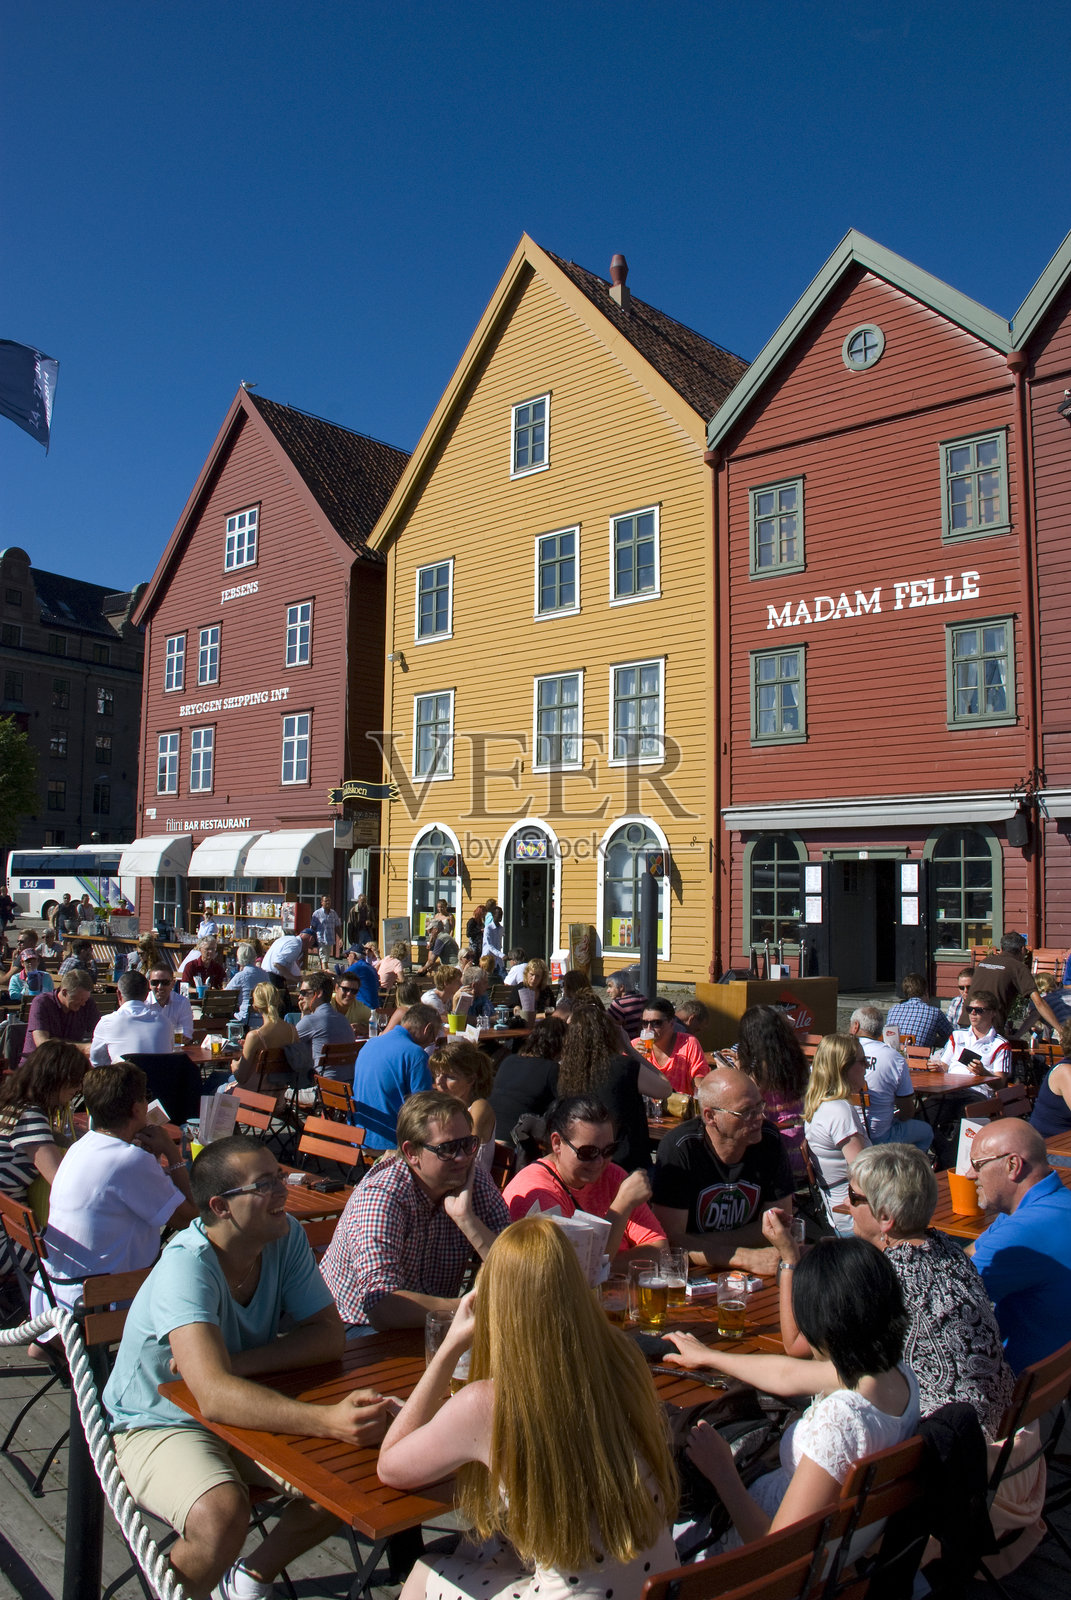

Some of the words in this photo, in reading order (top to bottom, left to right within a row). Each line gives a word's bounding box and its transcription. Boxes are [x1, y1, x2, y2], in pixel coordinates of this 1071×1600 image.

[220, 580, 259, 605] JEBSENS
[766, 587, 882, 630] MADAM
[893, 570, 981, 611] FELLE
[178, 698, 223, 717] BRYGGEN
[223, 691, 269, 710] SHIPPING
[270, 687, 290, 702] INT
[166, 818, 183, 832] filini
[184, 820, 199, 831] BAR
[200, 817, 251, 831] RESTAURANT
[516, 841, 546, 856] MIX
[23, 880, 40, 889] SAS
